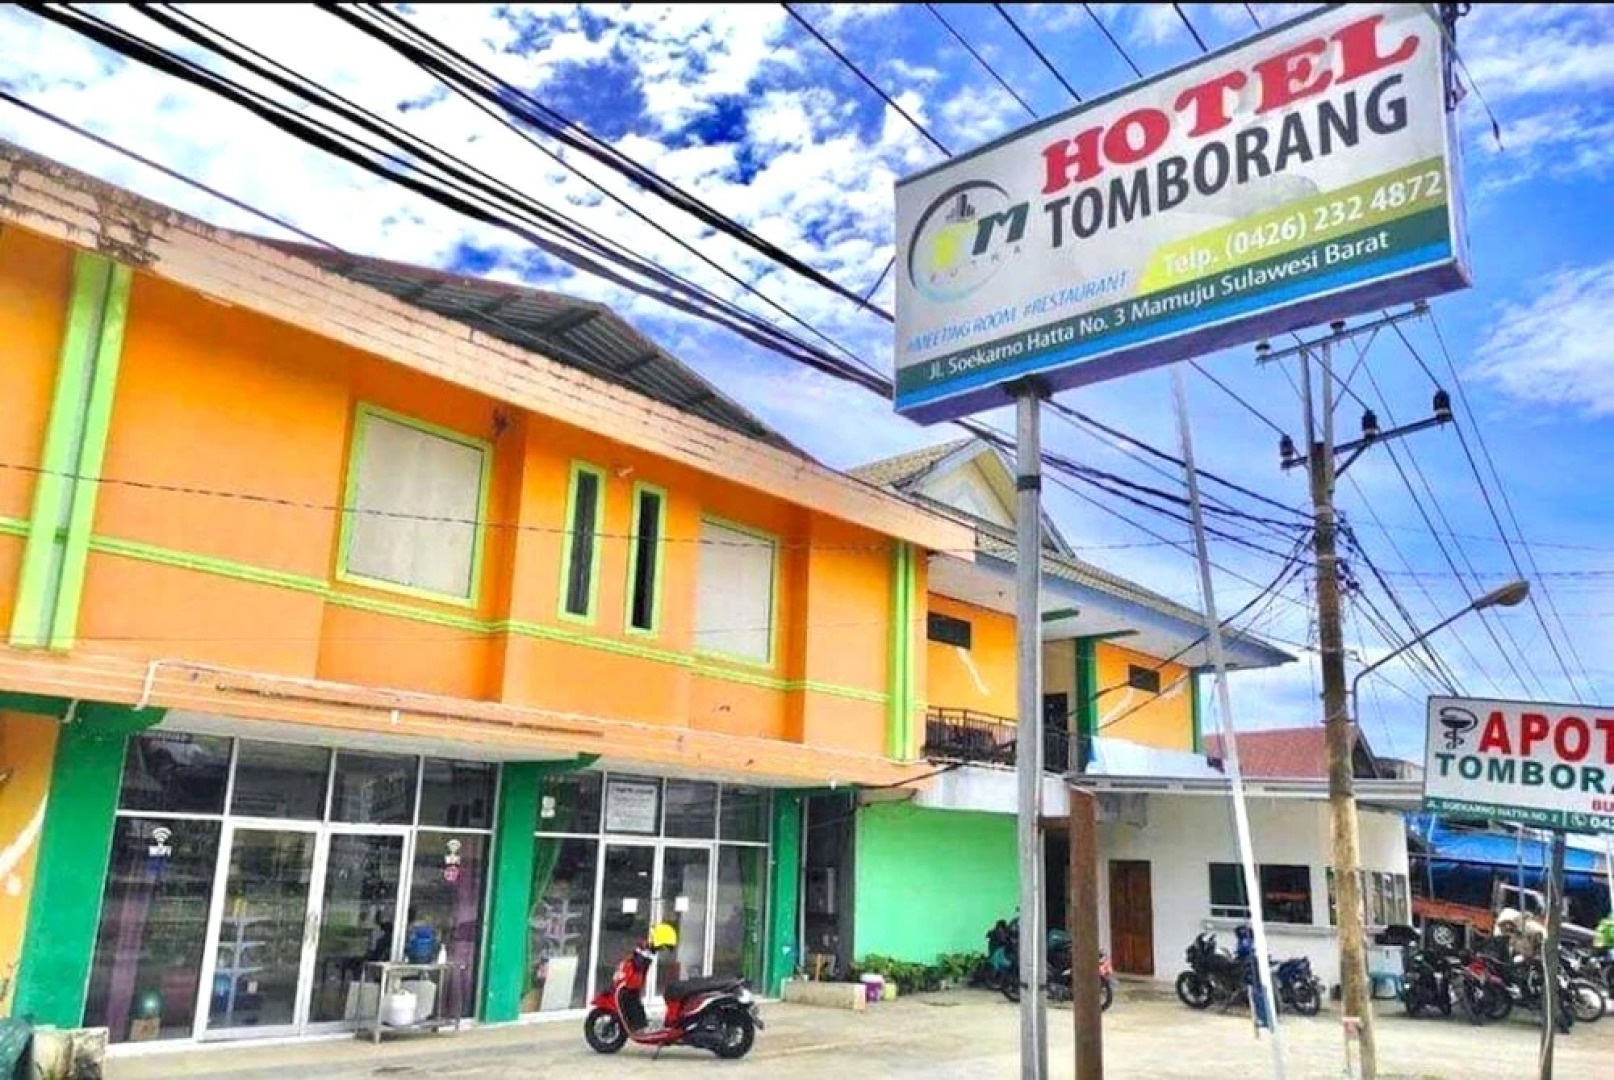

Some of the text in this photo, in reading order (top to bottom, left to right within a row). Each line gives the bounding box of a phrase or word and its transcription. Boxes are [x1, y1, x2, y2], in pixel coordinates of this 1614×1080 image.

[1041, 14, 1420, 195] HOTEL
[1044, 73, 1409, 248] TOMBORANG
[1163, 170, 1443, 277] Telp. (0426) 232 4872
[949, 340, 1023, 375] Soekarno
[1027, 326, 1075, 350] Hatta
[1079, 317, 1109, 339] No.
[1114, 308, 1126, 327] 3
[1130, 283, 1216, 323] Mamuju
[1221, 249, 1320, 296] Sulawesi
[1324, 231, 1390, 266] Barat
[1435, 753, 1614, 795] TOMBOR
